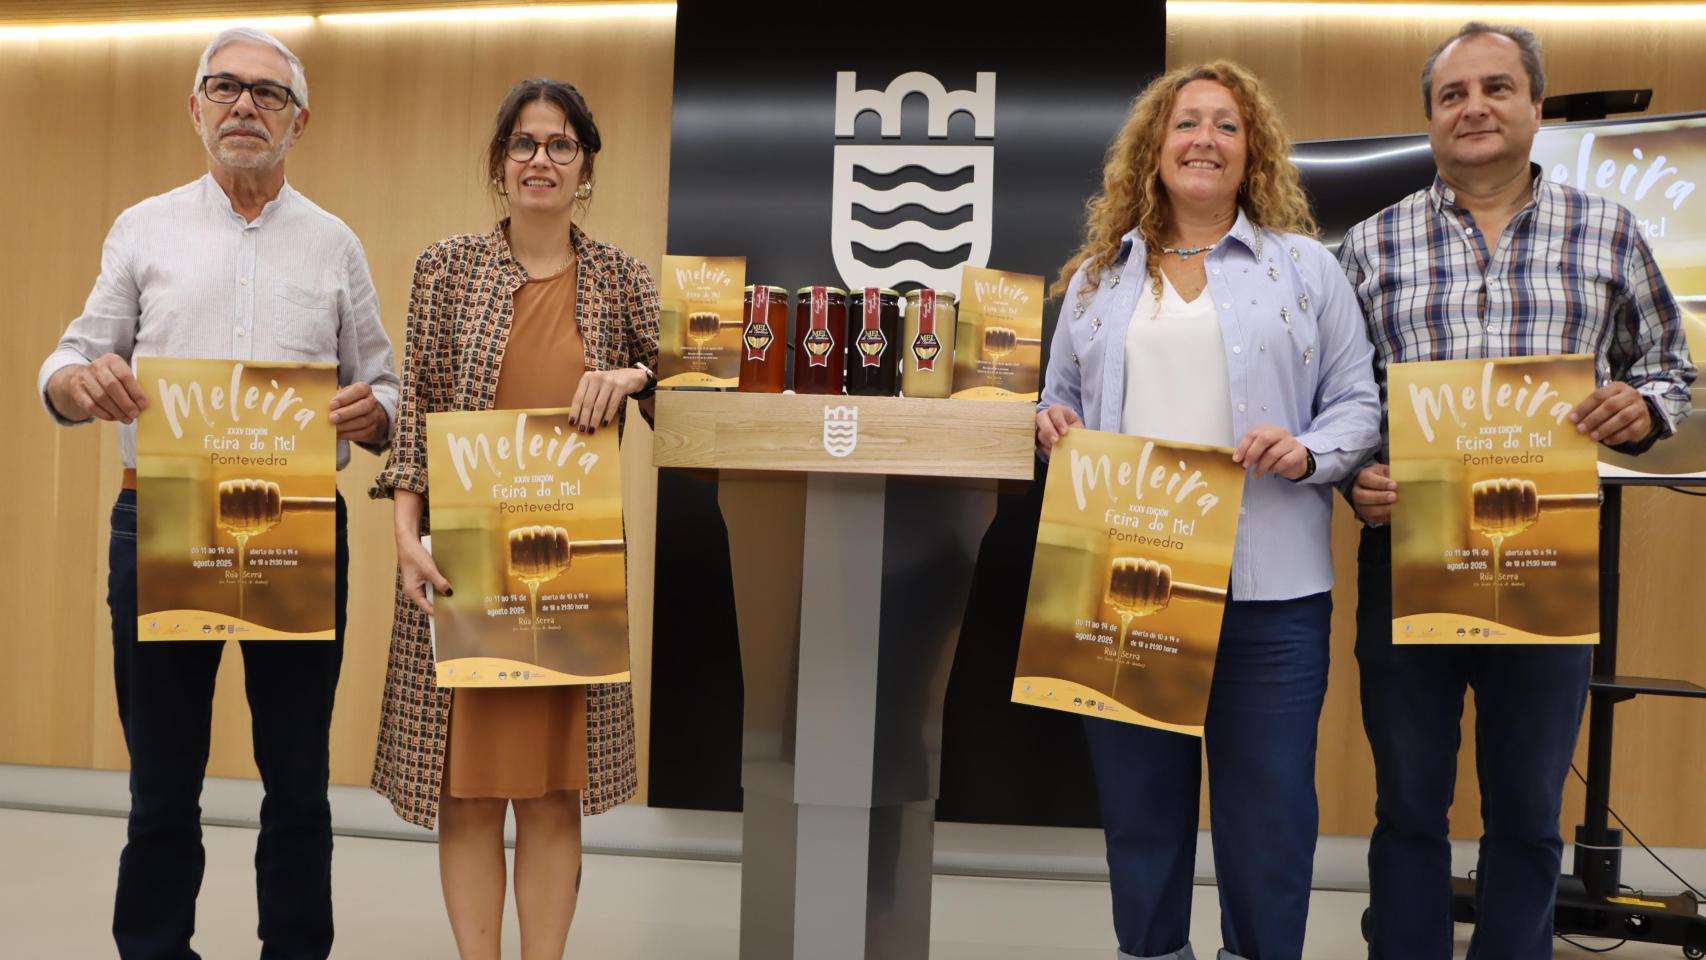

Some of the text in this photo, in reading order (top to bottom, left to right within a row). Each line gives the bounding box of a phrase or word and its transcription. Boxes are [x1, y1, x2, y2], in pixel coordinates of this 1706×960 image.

[1551, 132, 1696, 211] eleira
[675, 262, 732, 290] Meleira
[974, 277, 1030, 304] Meleira
[158, 363, 316, 439] Meleira
[1408, 362, 1573, 442] Meleira
[204, 433, 295, 451] Feira do Mel
[1456, 430, 1552, 450] Feira do Mel
[210, 452, 288, 466] Pontevedra
[447, 413, 599, 491] Meleira
[1463, 451, 1544, 466] Pontevedra
[1070, 440, 1220, 516] Meleira
[492, 480, 580, 498] Feira do Mel
[500, 500, 574, 513] Pontevedra
[1104, 508, 1196, 536] Feira do Mel
[1108, 528, 1184, 550] Pontevedra
[193, 560, 214, 568] agosto
[1447, 562, 1488, 571] agosto 2025
[1498, 572, 1518, 580] Serra
[488, 606, 525, 617] agosto 2025
[1110, 624, 1118, 632] de
[1075, 632, 1114, 644] agosto 2025
[1120, 650, 1140, 660] Serra
